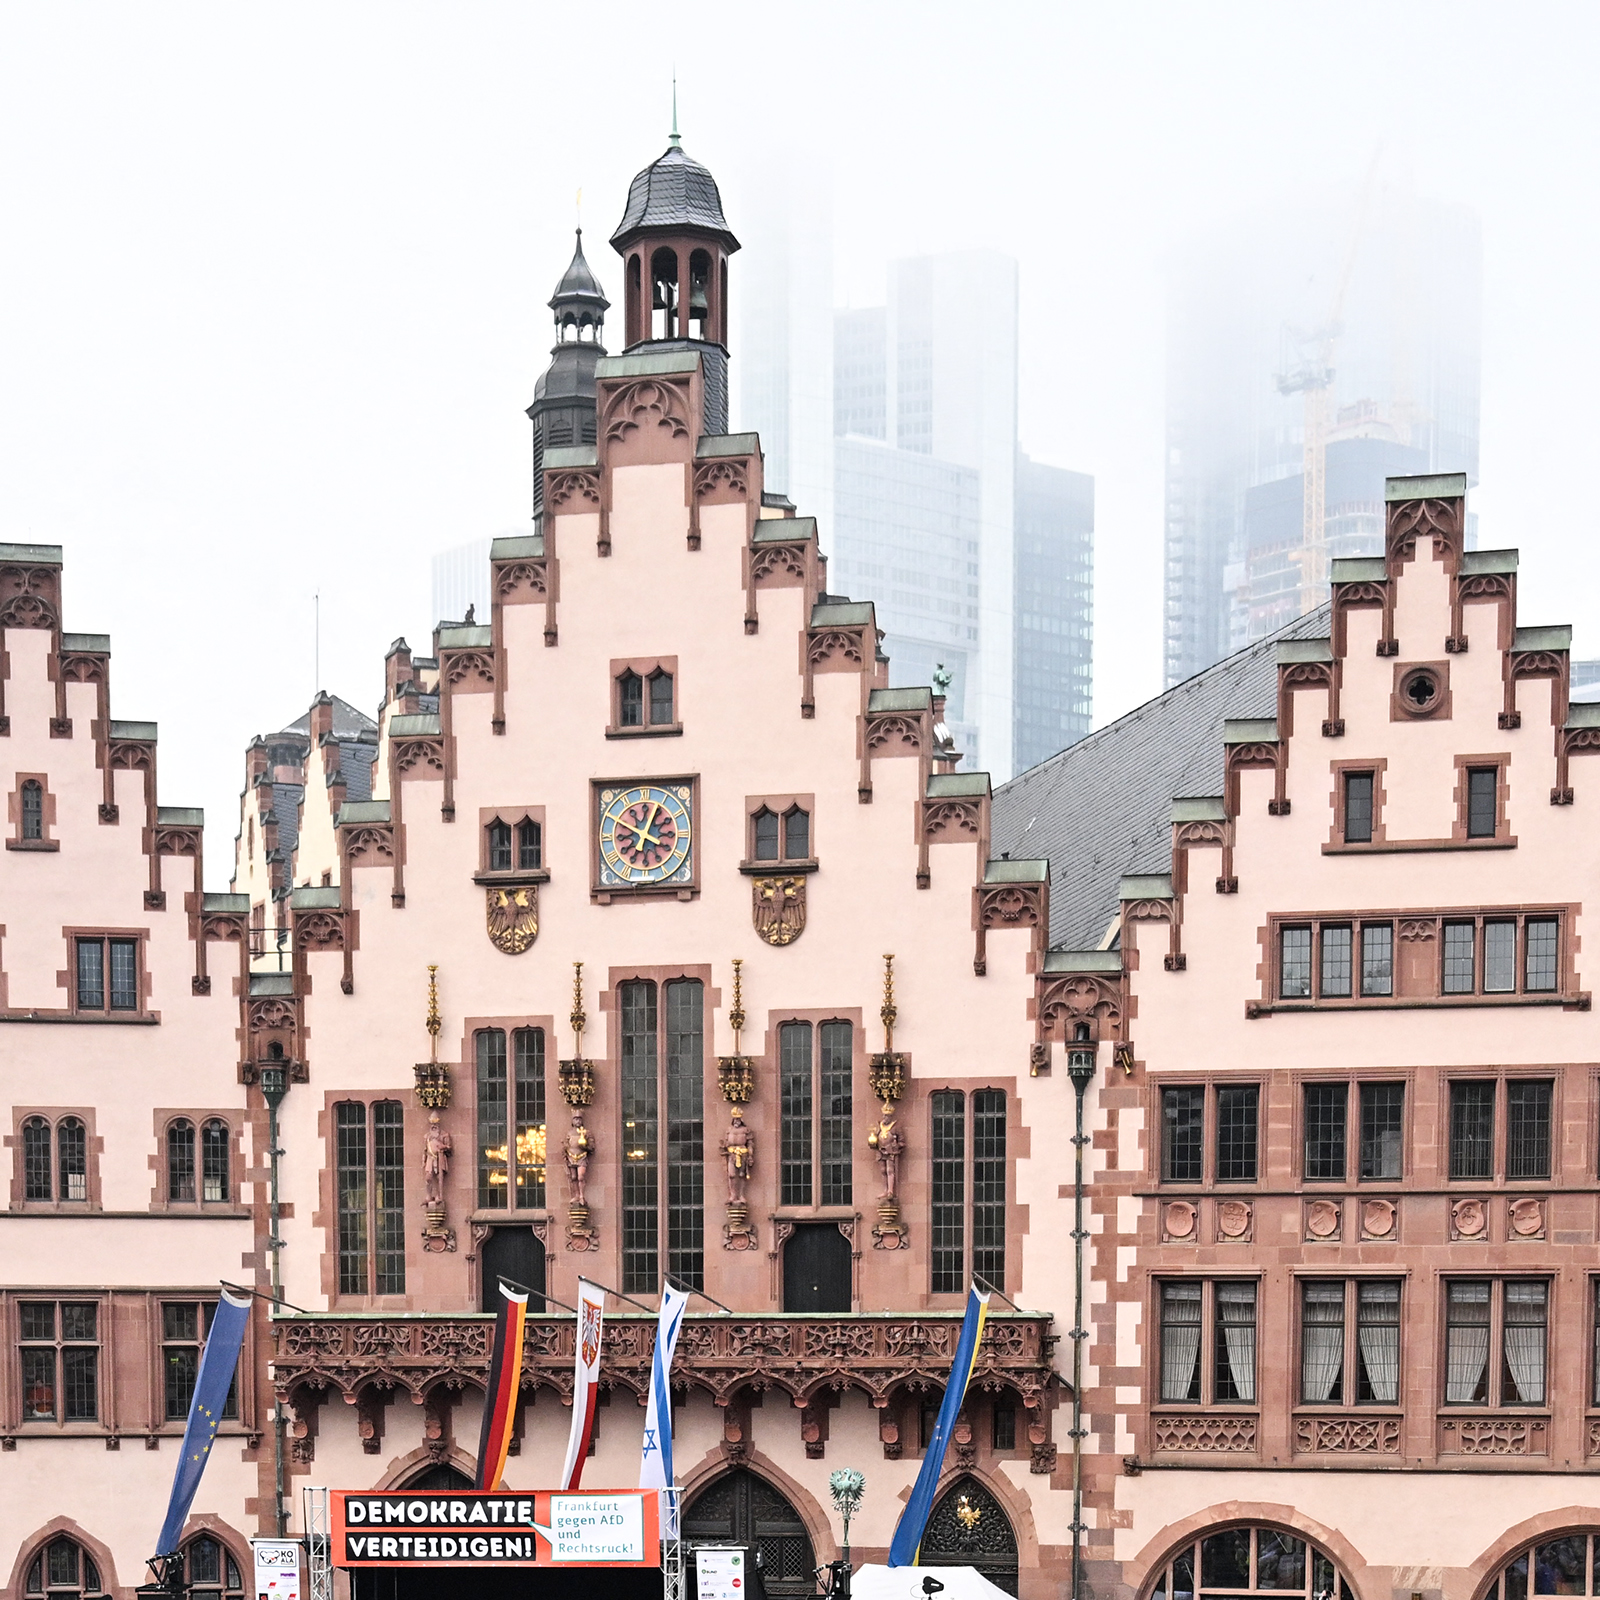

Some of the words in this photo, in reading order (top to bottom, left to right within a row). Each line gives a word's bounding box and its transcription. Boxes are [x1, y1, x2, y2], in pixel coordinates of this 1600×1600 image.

[348, 1500, 532, 1524] DEMOKRATIE
[557, 1501, 619, 1512] Frankfurt
[557, 1515, 596, 1528] gegen
[600, 1514, 624, 1525] AfD
[557, 1528, 581, 1539] und
[348, 1536, 532, 1558] VERTEIDIGEN!
[558, 1543, 634, 1554] Rechtsruck!
